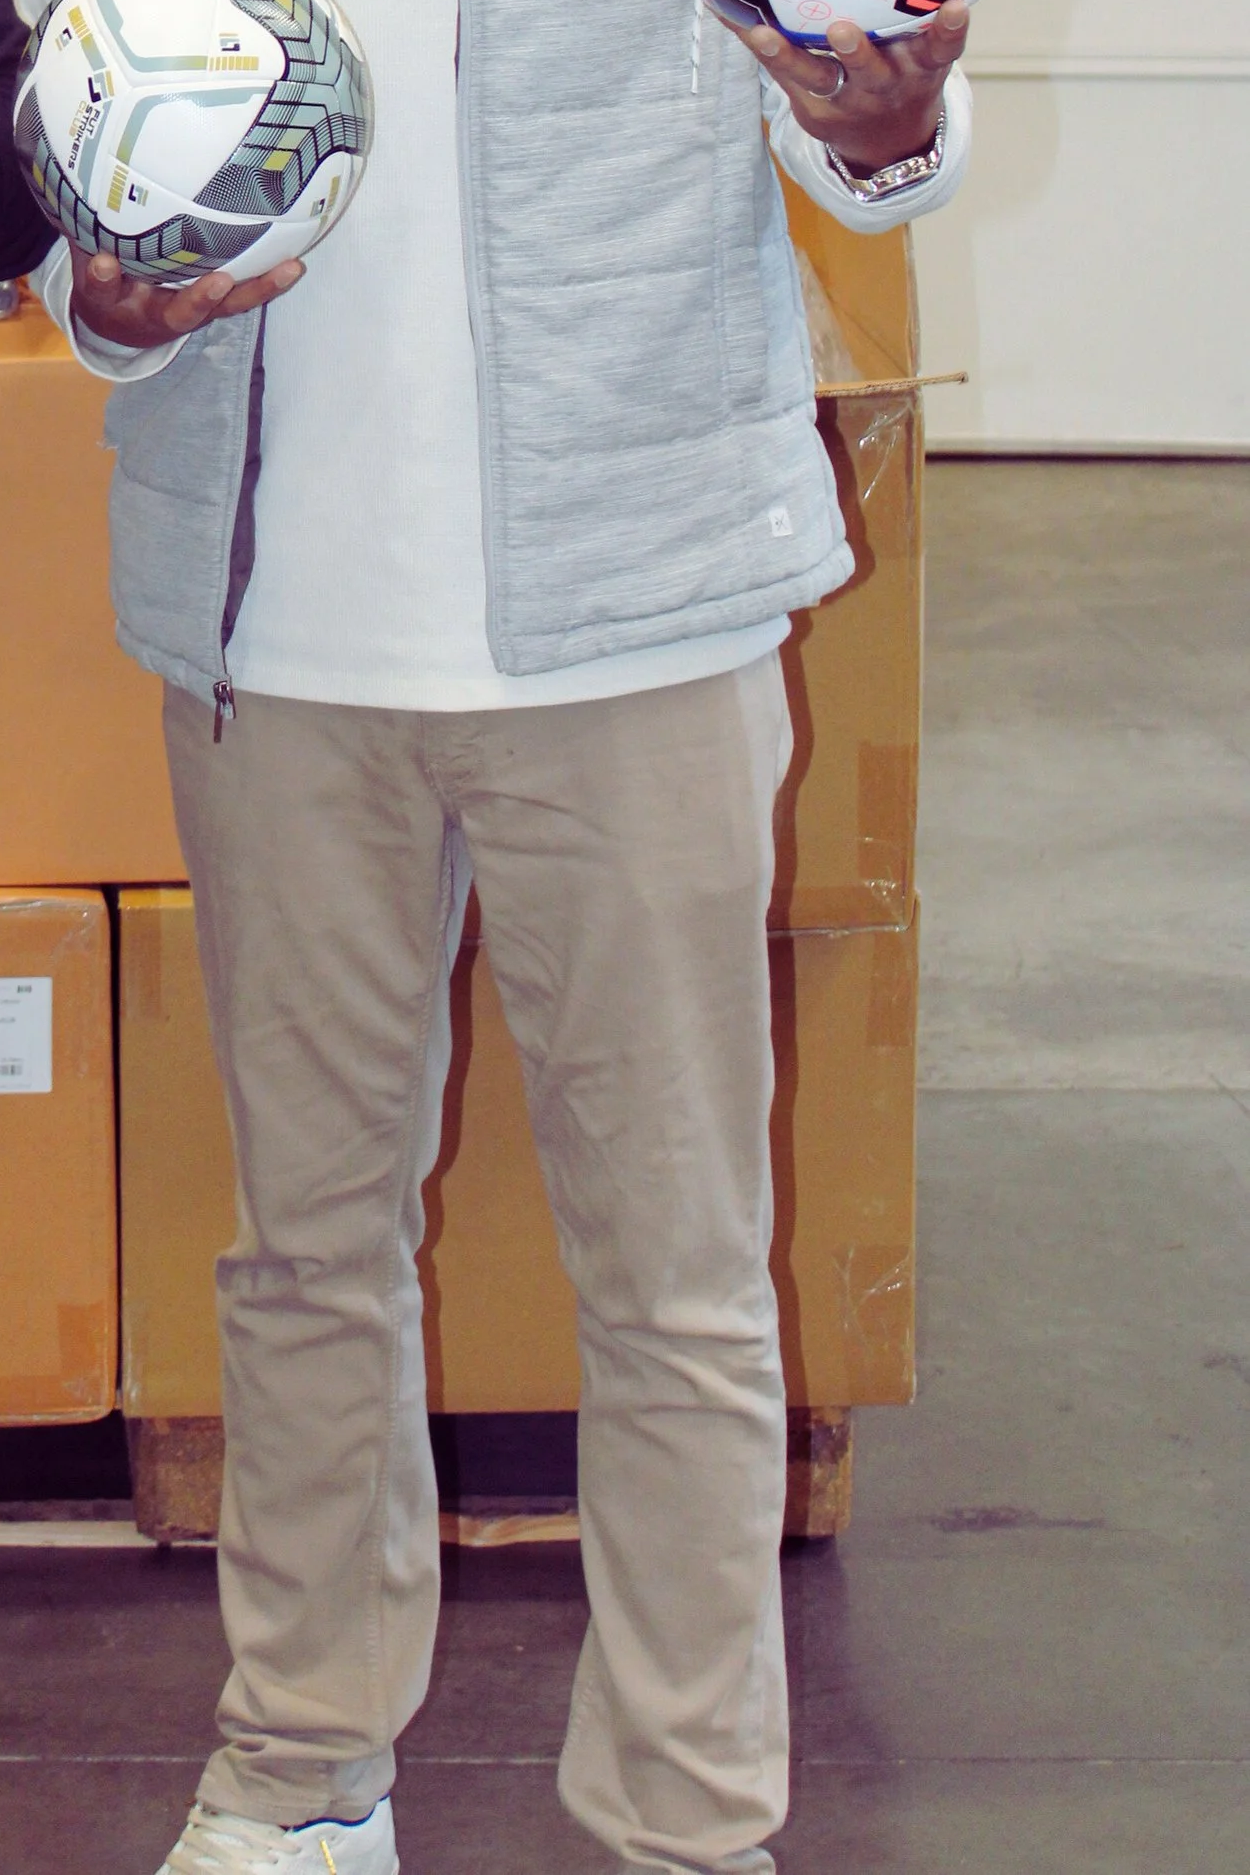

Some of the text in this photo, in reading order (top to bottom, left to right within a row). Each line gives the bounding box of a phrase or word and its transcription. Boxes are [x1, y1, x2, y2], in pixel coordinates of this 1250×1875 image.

[68, 100, 87, 137] CLUB
[68, 104, 93, 170] STRIKERS
[87, 109, 101, 136] FUT
